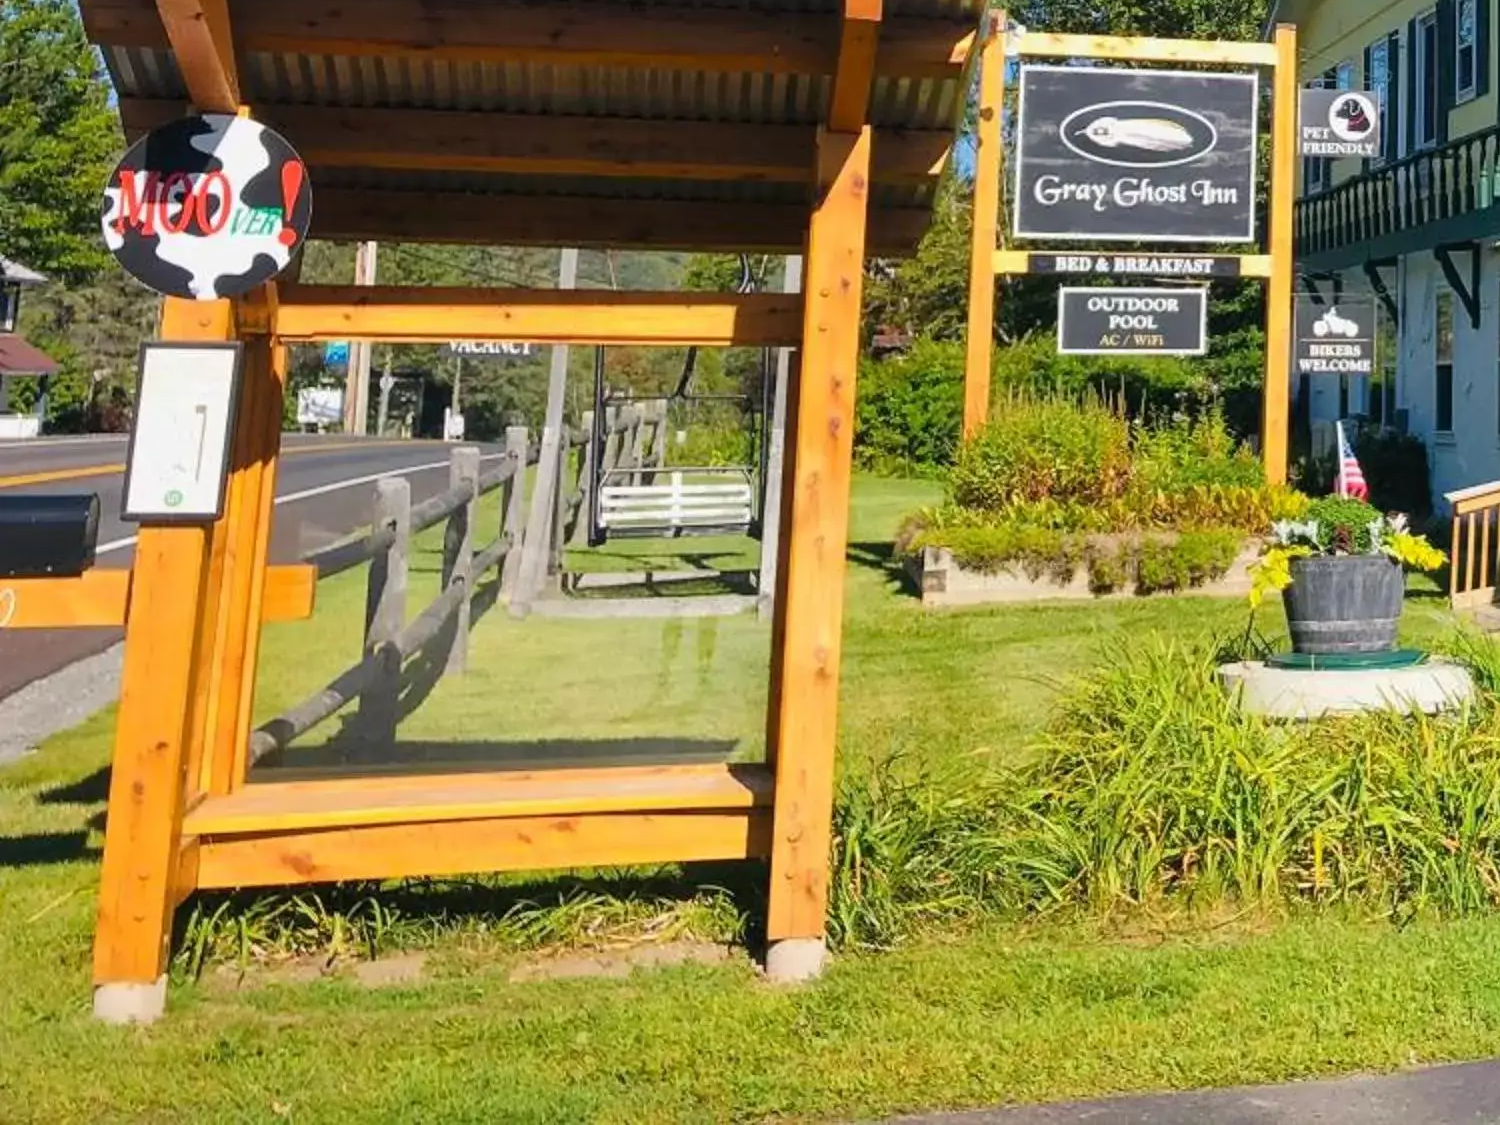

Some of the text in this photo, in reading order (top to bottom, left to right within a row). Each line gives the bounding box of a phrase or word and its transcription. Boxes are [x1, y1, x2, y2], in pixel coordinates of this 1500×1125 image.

[1303, 126, 1329, 139] PET
[1303, 141, 1374, 155] FRIENDLY
[1034, 175, 1237, 211] Gray Ghost Inn
[1055, 256, 1215, 273] BED & BREAKFAST
[1087, 297, 1179, 312] OUTDOOR
[1109, 314, 1158, 329] POOL
[1100, 334, 1120, 346] AC
[1309, 344, 1361, 357] BIKERS
[1299, 358, 1371, 372] WELCOME
